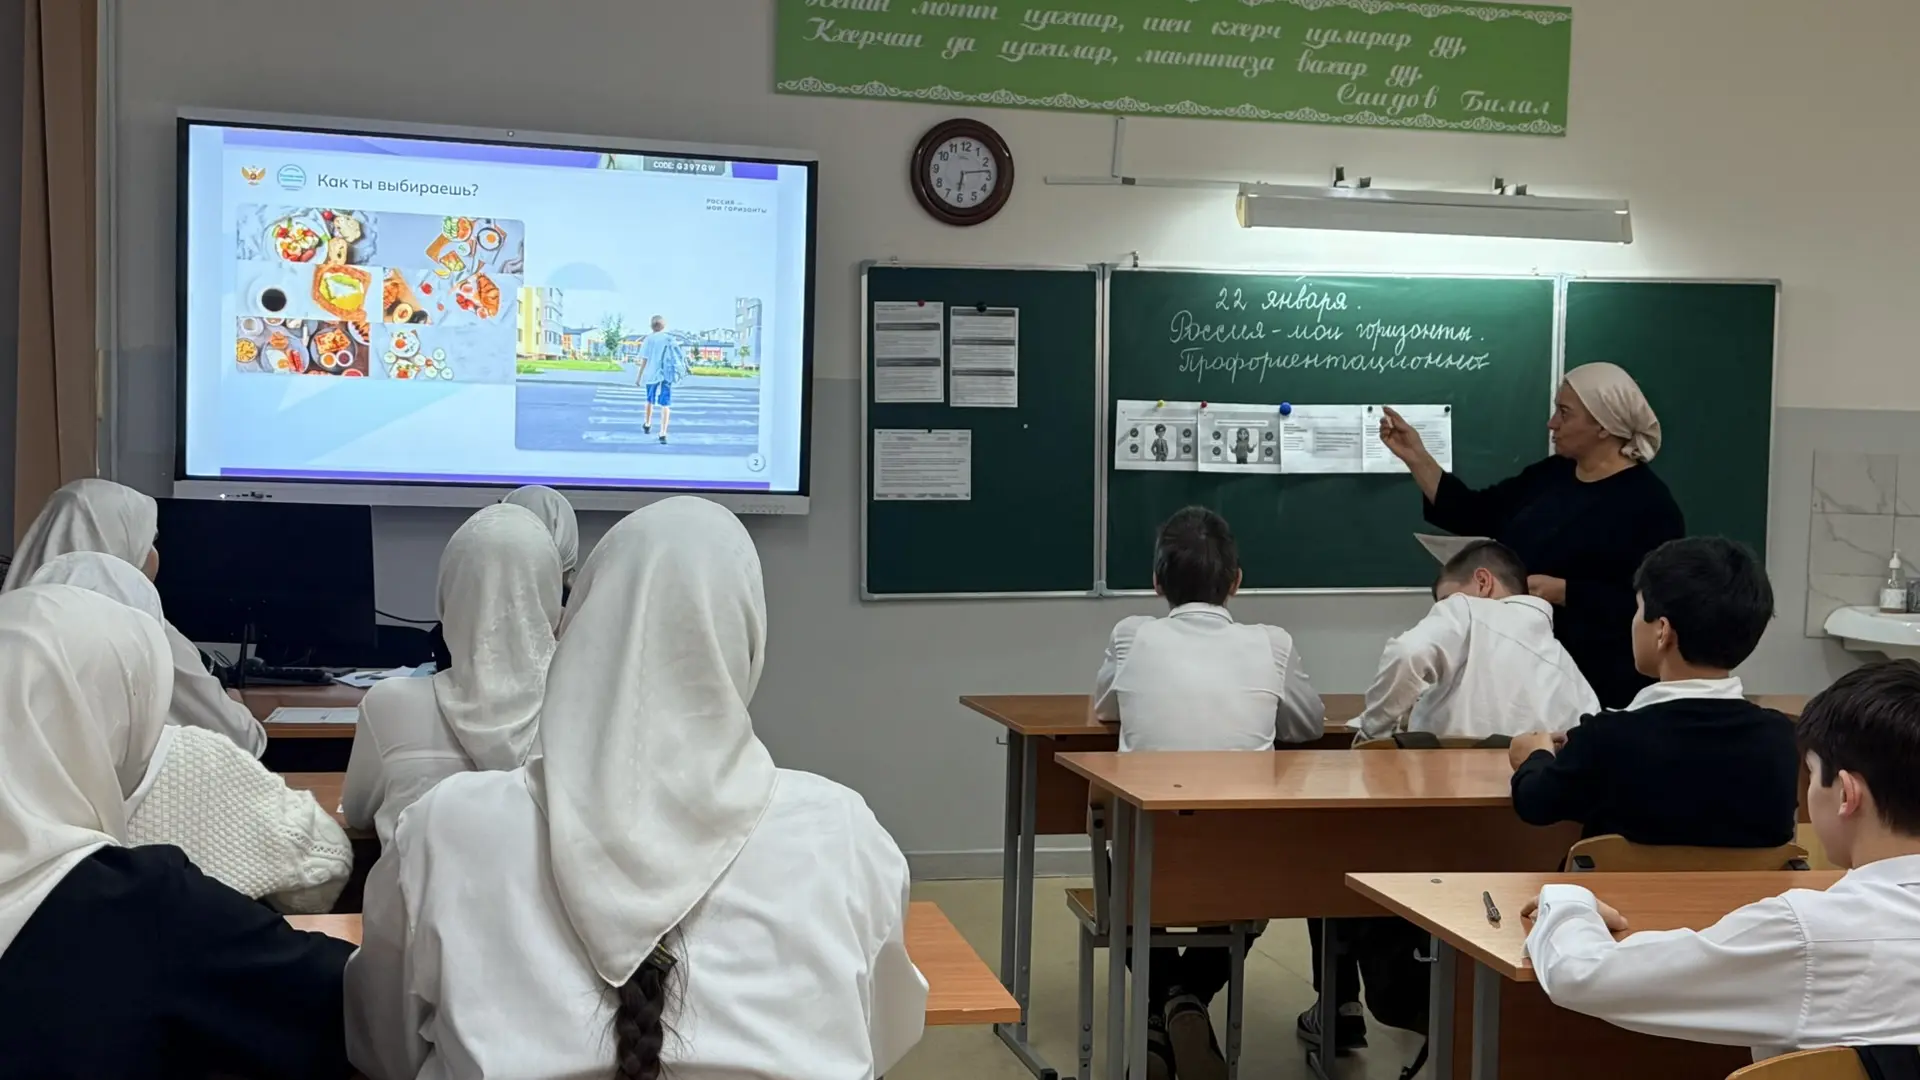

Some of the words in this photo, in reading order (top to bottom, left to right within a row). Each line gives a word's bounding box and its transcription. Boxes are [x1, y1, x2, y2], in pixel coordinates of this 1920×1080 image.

[912, 1, 1000, 20] мотт
[1142, 17, 1191, 33] шен
[1211, 21, 1282, 42] кхерч
[802, 17, 924, 50] Кхерчан
[941, 36, 977, 60] да
[1295, 49, 1368, 80] вахар
[1337, 82, 1440, 115] Саидов
[1461, 90, 1550, 115] Билал
[949, 143, 958, 153] 11
[961, 141, 972, 152] 12
[938, 150, 949, 161] 10
[982, 157, 989, 167] 2
[933, 163, 940, 174] 9
[985, 170, 992, 181] 3
[317, 173, 348, 189] Как
[352, 179, 373, 190] ты
[377, 179, 479, 197] выбираешь?
[936, 177, 943, 188] 8
[980, 183, 987, 193] 4
[944, 188, 951, 198] 7
[956, 193, 963, 203] 6
[971, 191, 977, 201] 5
[706, 198, 735, 206] РОССИЯ
[724, 205, 767, 214] ГОРИЗОНТЫ
[1215, 287, 1248, 311] 22
[753, 458, 759, 466] 2
